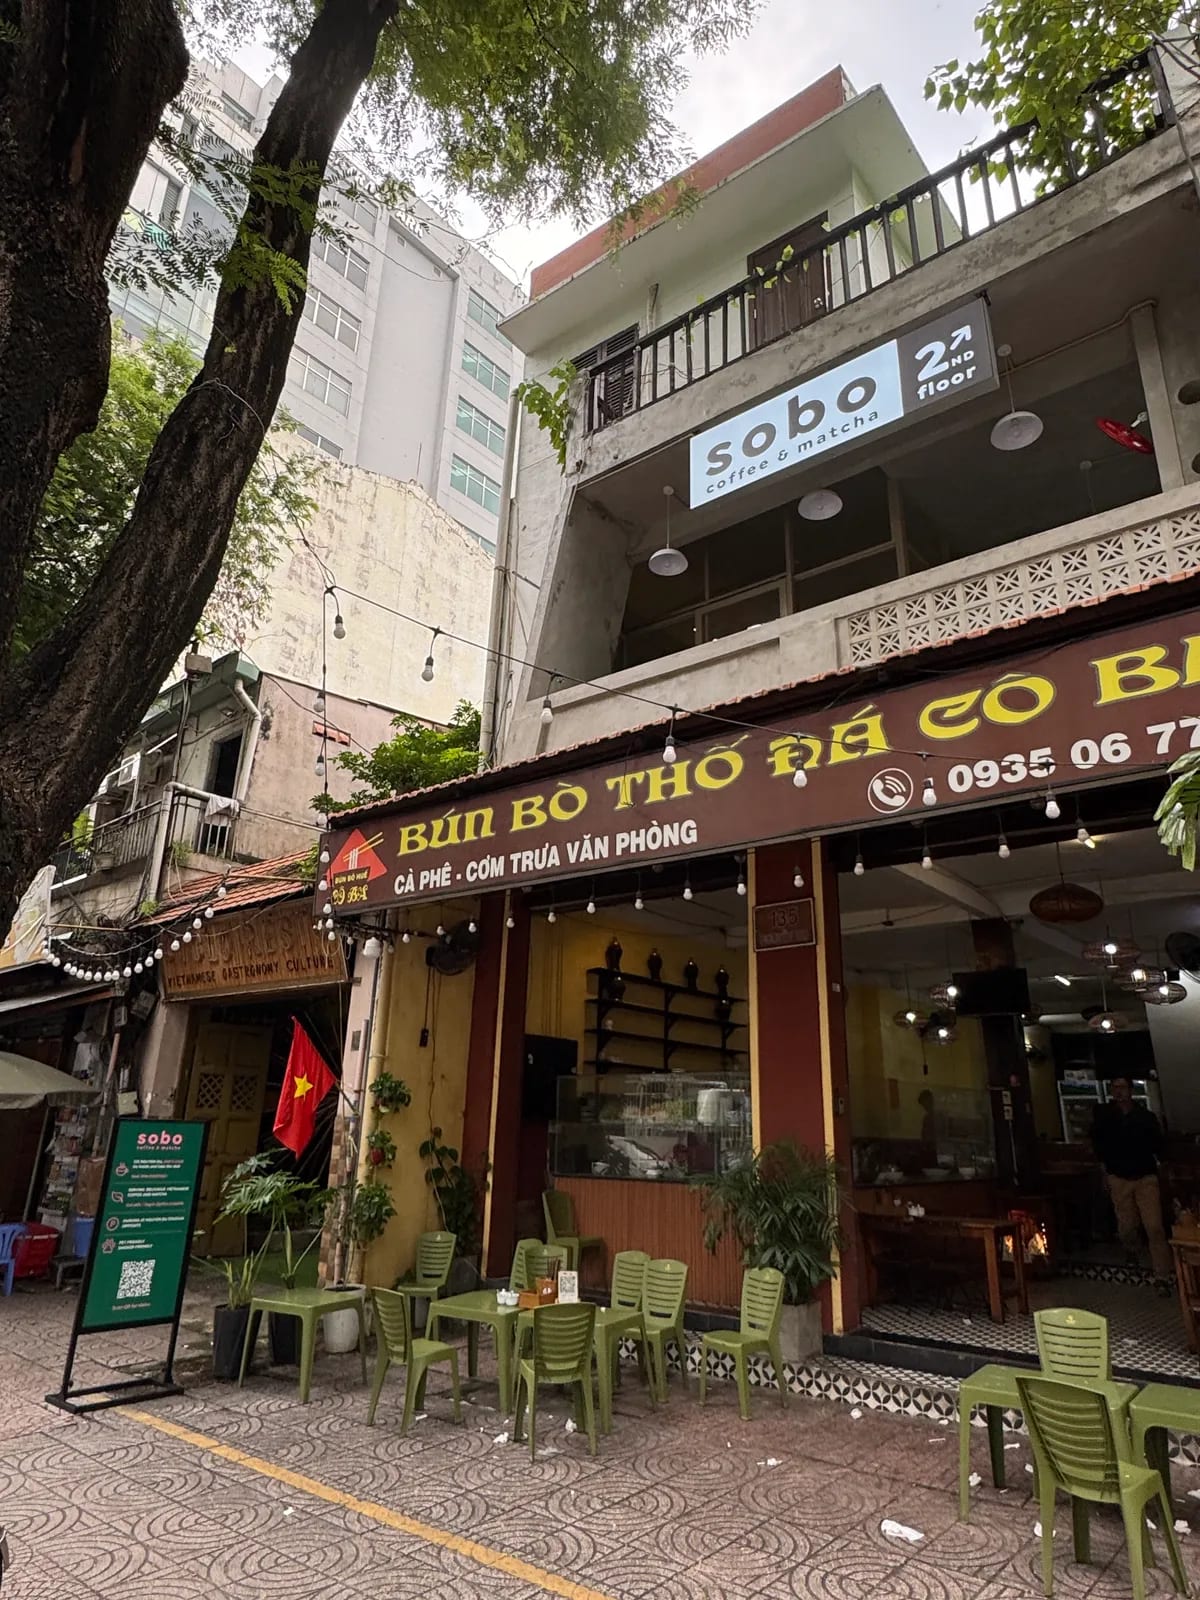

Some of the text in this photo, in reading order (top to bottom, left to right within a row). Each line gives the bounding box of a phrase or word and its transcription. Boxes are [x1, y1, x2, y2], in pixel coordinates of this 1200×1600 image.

[917, 366, 977, 400] floor
[705, 376, 877, 477] sobo
[706, 411, 879, 494] coffee & matcha
[509, 782, 588, 833] BÒ
[606, 734, 750, 811] THỐ
[767, 704, 892, 777] ĐÁ
[918, 673, 1057, 740] CÔ
[947, 747, 1057, 794] 0935
[1070, 732, 1132, 769] 06
[394, 868, 415, 895] CÀ
[419, 861, 452, 891] PHÊ
[466, 855, 505, 882] CƠM
[510, 842, 560, 874] TRƯA
[566, 832, 609, 863] VĂN
[616, 819, 698, 856] PHÒNG
[168, 970, 216, 988] VIETNAMESE
[137, 1130, 183, 1145] sobo
